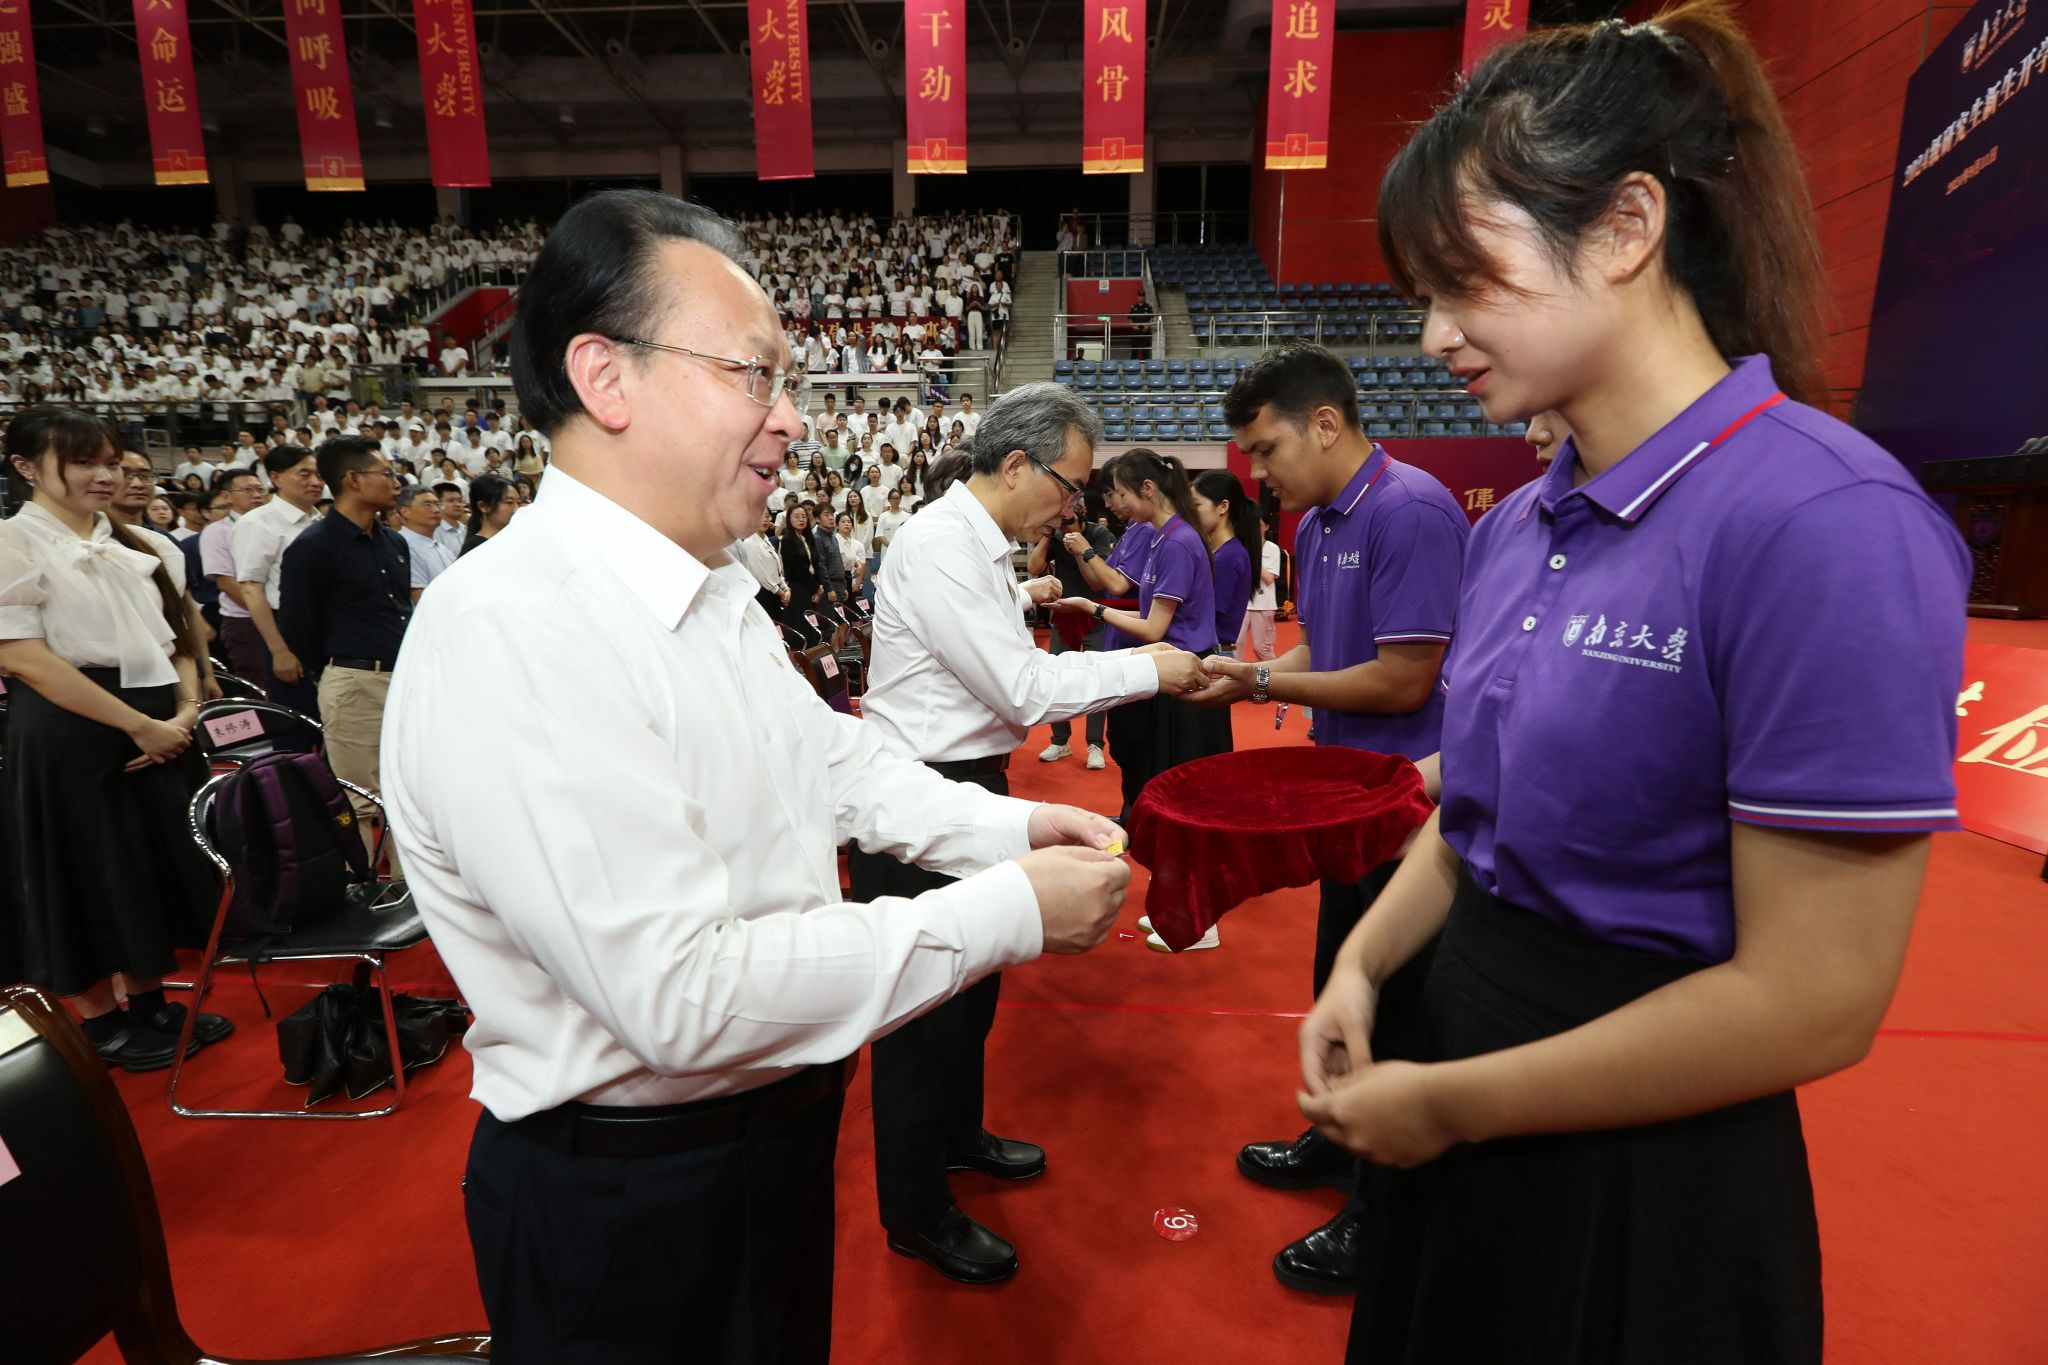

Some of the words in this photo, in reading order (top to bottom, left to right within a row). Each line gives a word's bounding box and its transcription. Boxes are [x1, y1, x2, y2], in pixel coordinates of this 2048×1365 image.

[918, 10, 952, 102] 干劲
[1096, 6, 1133, 102] 风骨
[1283, 2, 1321, 98] 追求
